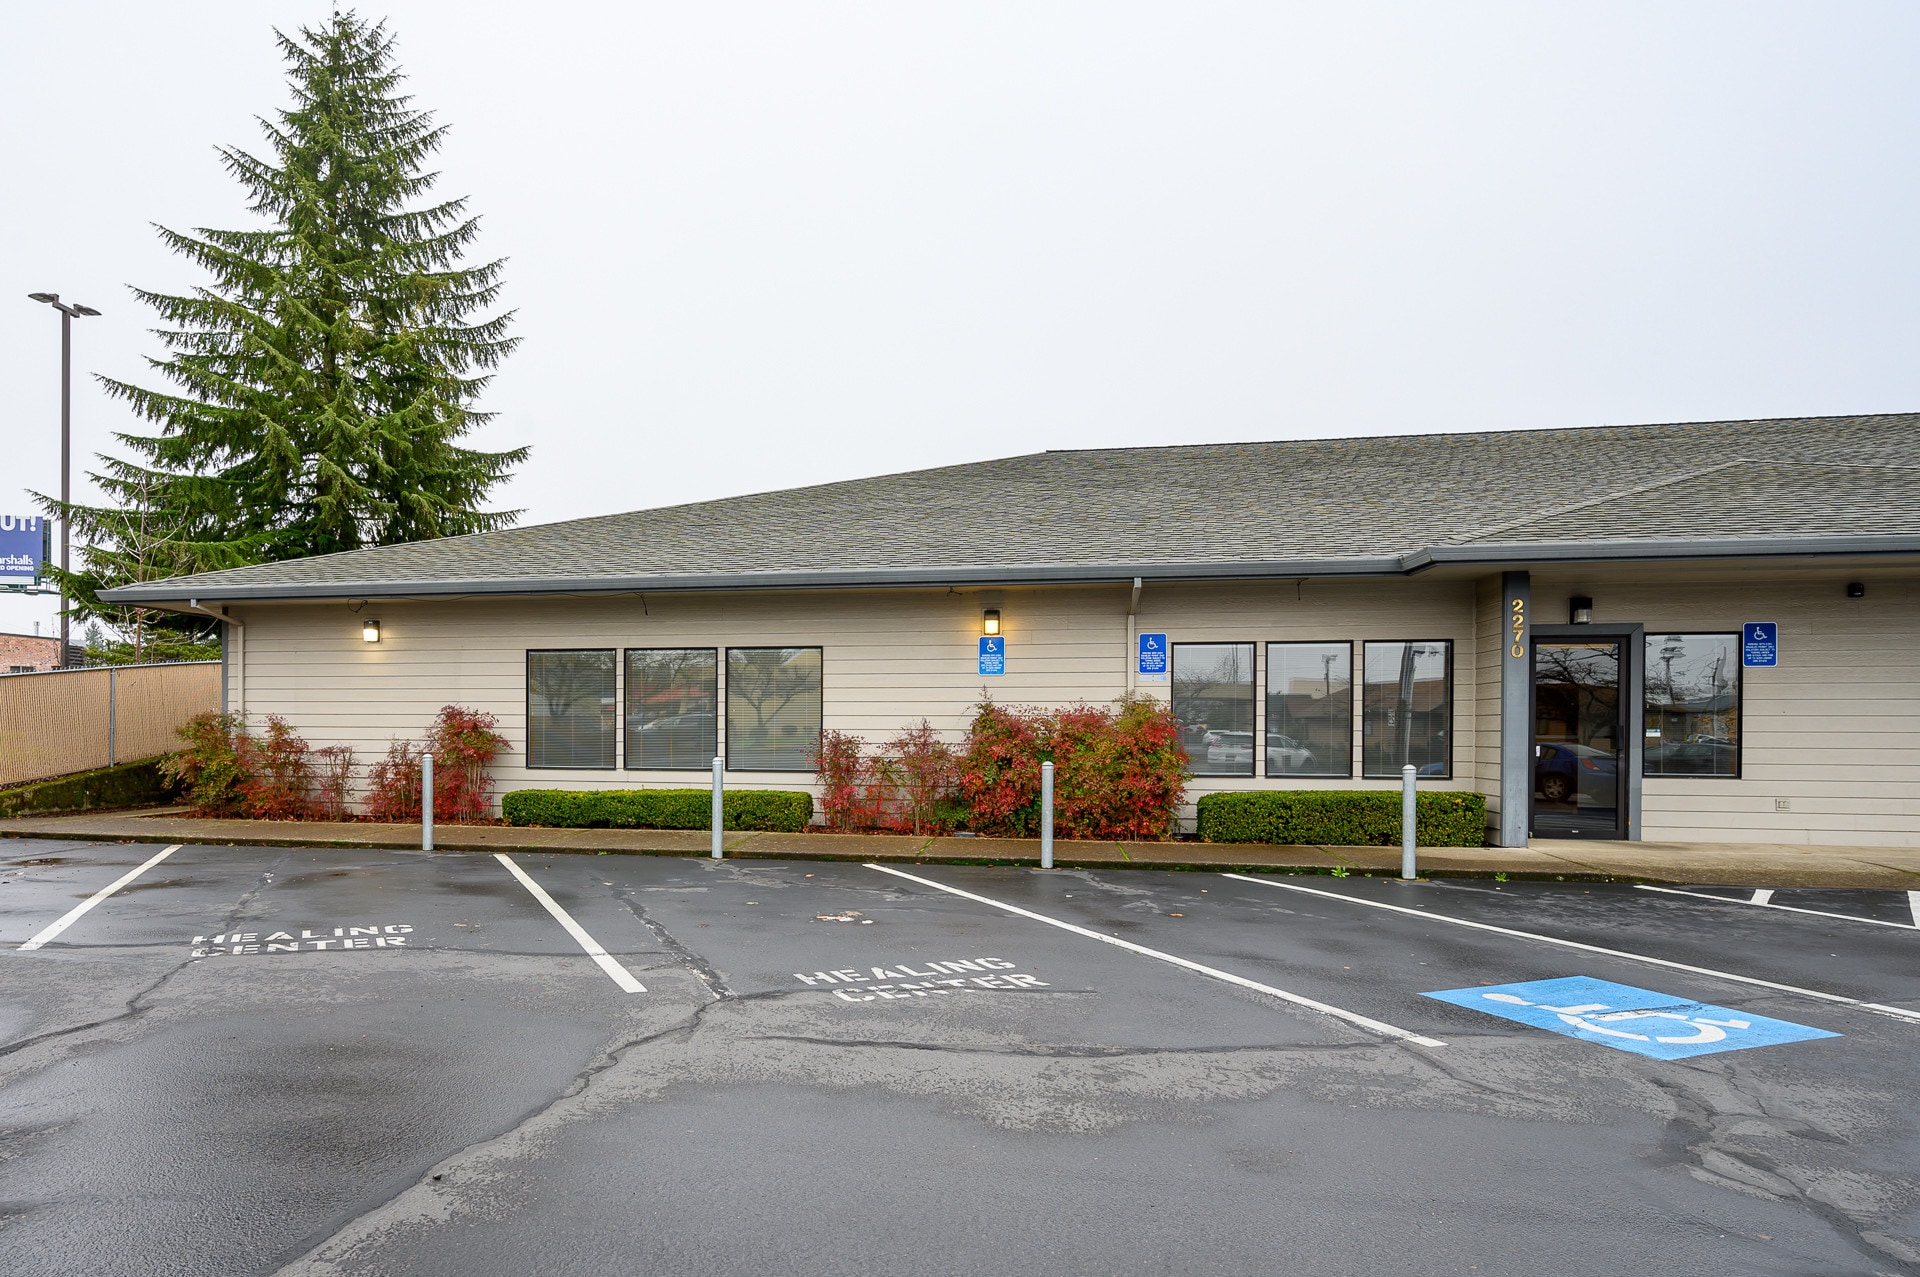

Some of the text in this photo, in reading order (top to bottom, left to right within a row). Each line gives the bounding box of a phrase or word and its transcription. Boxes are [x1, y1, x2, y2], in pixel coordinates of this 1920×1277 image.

[1511, 598, 1524, 659] 2270
[191, 924, 414, 945] HEALING
[793, 957, 1016, 985] HEALING
[832, 973, 1051, 1002] CENTER
